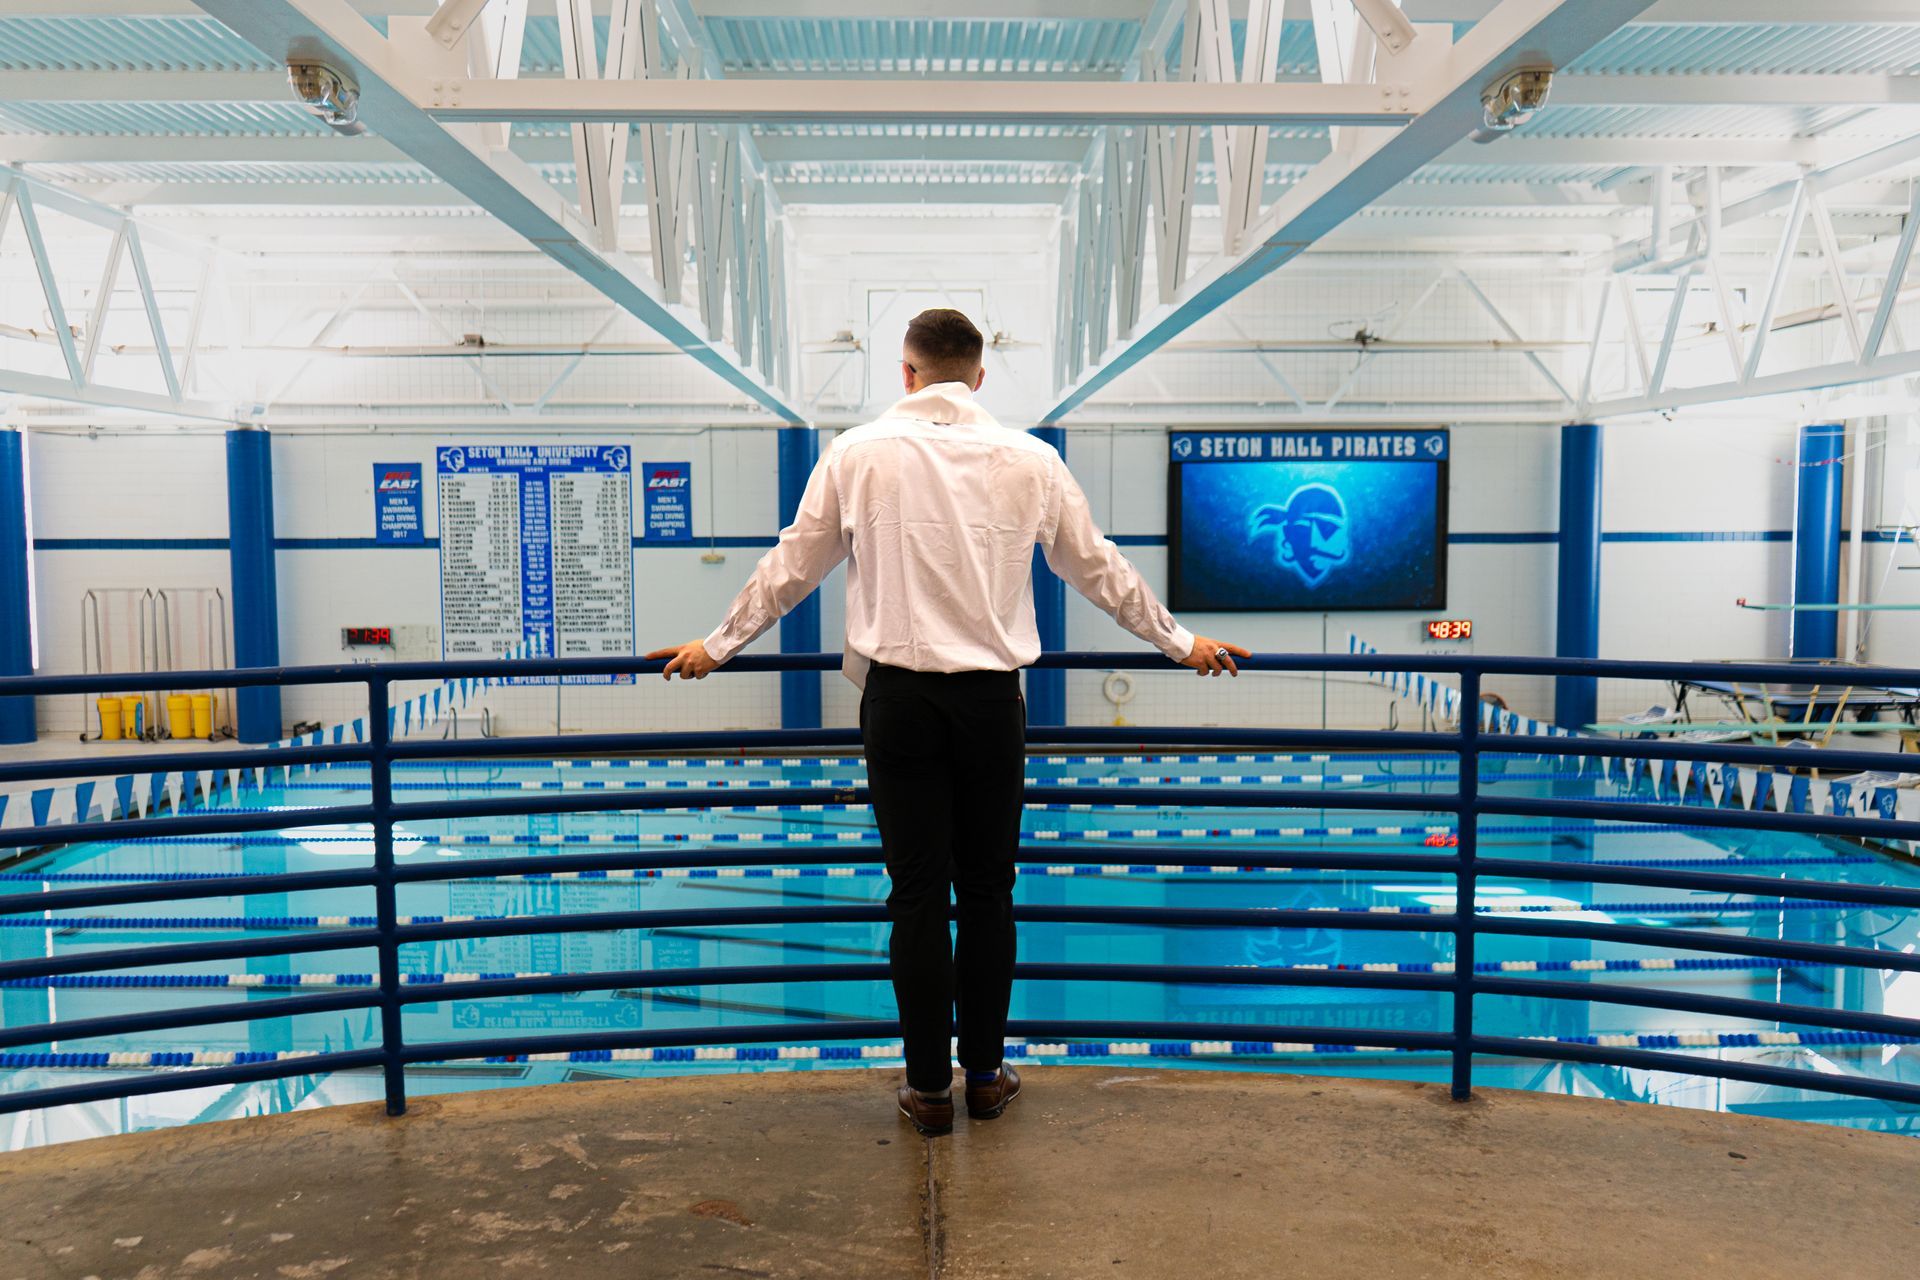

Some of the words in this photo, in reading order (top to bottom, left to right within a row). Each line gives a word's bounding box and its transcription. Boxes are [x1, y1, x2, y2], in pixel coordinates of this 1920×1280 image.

[1200, 437, 1262, 457] SETON
[1271, 437, 1323, 457] HALL
[1332, 436, 1416, 457] PIRATES
[468, 446, 502, 459] SETON
[505, 446, 533, 458] HALL
[537, 446, 599, 458] UNIVERSITY
[496, 458, 531, 466] SWIMMING
[533, 458, 547, 466] AND
[549, 458, 572, 466] DIVING
[379, 479, 420, 489] EAST
[648, 478, 688, 488] EAST
[389, 497, 409, 505] MEN'S
[382, 505, 416, 514] SWIMMING
[651, 504, 684, 512] SWIMMING
[382, 514, 396, 522] AND
[396, 514, 418, 522] DIVING
[650, 512, 664, 520] AND
[664, 512, 686, 520] DIVING
[382, 522, 418, 530] CHAMPIONS
[650, 520, 686, 529] CHAMPIONS
[1429, 621, 1471, 639] 48:39
[561, 675, 612, 685] NATATORIUM
[1711, 769, 1722, 786] 2
[1859, 791, 1868, 812] 1
